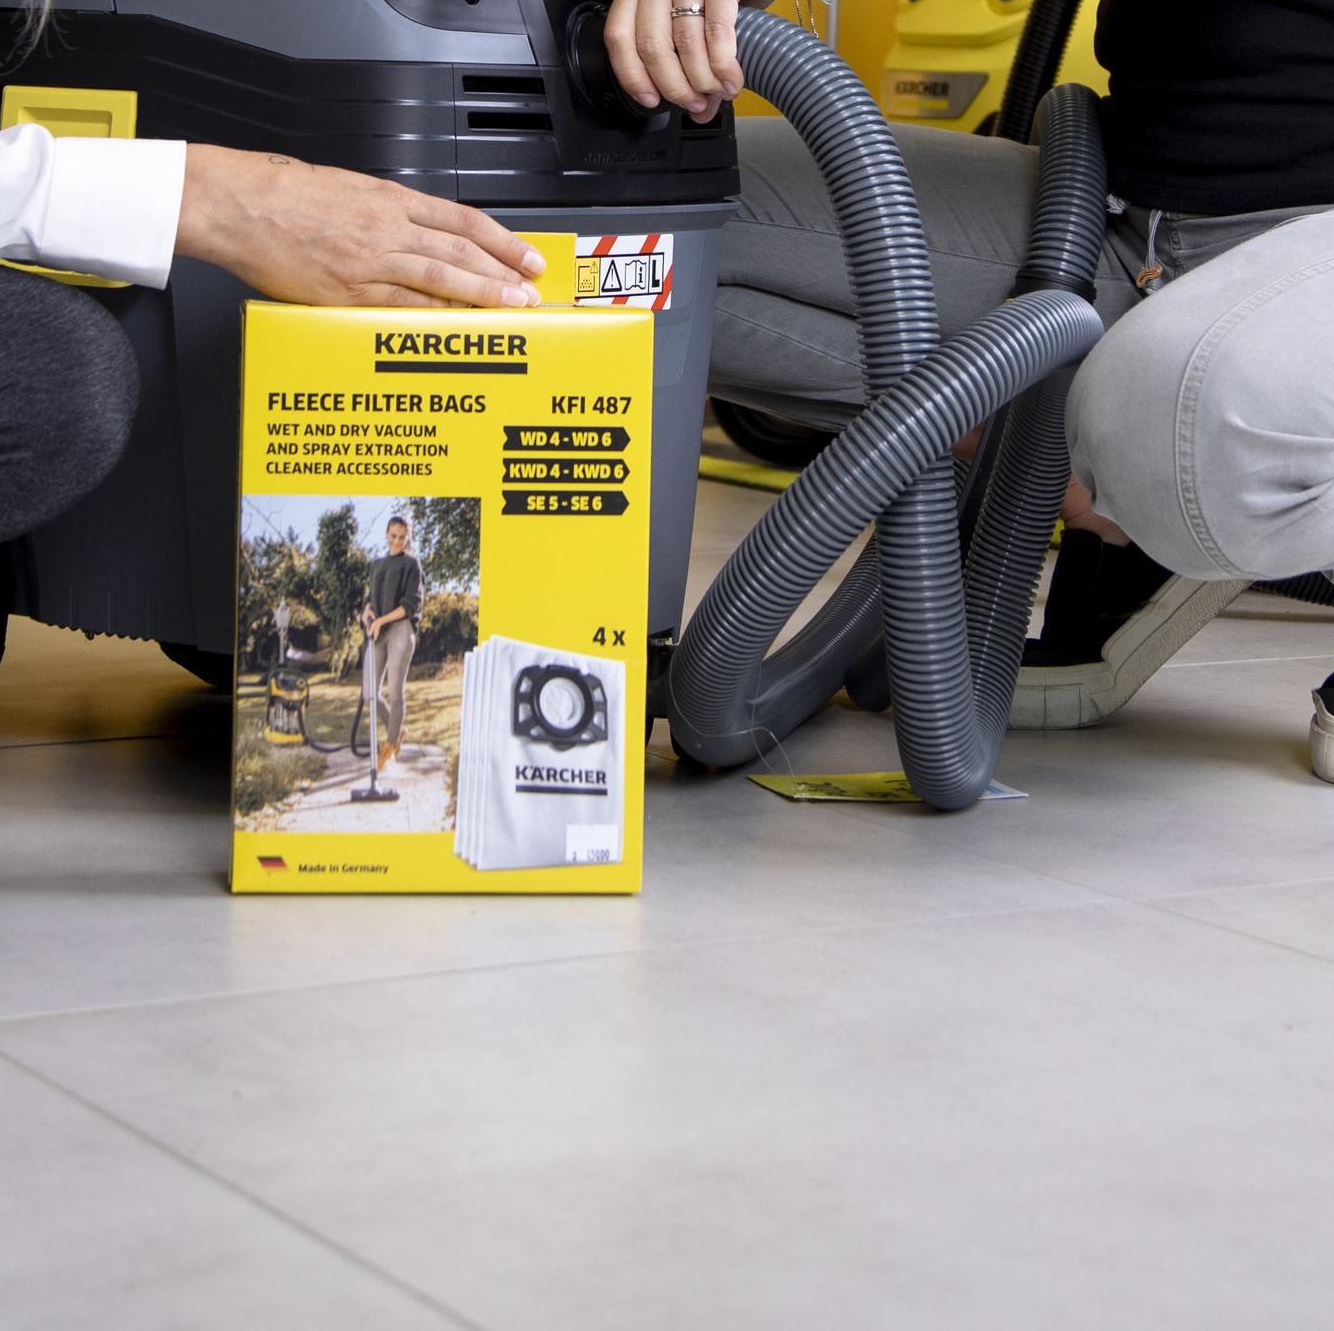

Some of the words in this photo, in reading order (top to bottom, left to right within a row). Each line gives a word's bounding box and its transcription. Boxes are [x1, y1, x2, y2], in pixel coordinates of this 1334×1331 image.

[375, 332, 527, 356] KÄRCHER
[267, 392, 345, 412] FLEECE
[352, 393, 423, 413] FILTER
[429, 394, 486, 413] BAGS
[551, 396, 586, 415] KFI
[592, 396, 632, 415] 487
[267, 423, 300, 436] WET
[304, 423, 336, 437] AND
[340, 424, 370, 437] DRY
[374, 425, 437, 438] VACUUM
[520, 431, 548, 447] WD
[549, 431, 560, 447] 4
[572, 431, 599, 447] WD
[601, 431, 612, 447] 6
[266, 442, 298, 455] AND
[303, 443, 351, 456] SPRAY
[355, 444, 448, 457] EXTRACTION
[266, 461, 332, 475] CLEANER
[336, 462, 432, 476] ACCESSORIES
[509, 463, 547, 479] KWD
[549, 463, 560, 479] 4
[573, 464, 611, 479] KWD
[614, 464, 624, 479] 6
[527, 495, 545, 511] SE
[549, 495, 559, 511] 5
[571, 495, 589, 511] SE
[592, 495, 603, 511] 6
[592, 627, 607, 647] 4
[612, 630, 626, 647] x
[515, 764, 607, 785] KÄRCHER
[298, 863, 326, 873] Made
[330, 863, 339, 873] in
[342, 863, 389, 875] Germany
